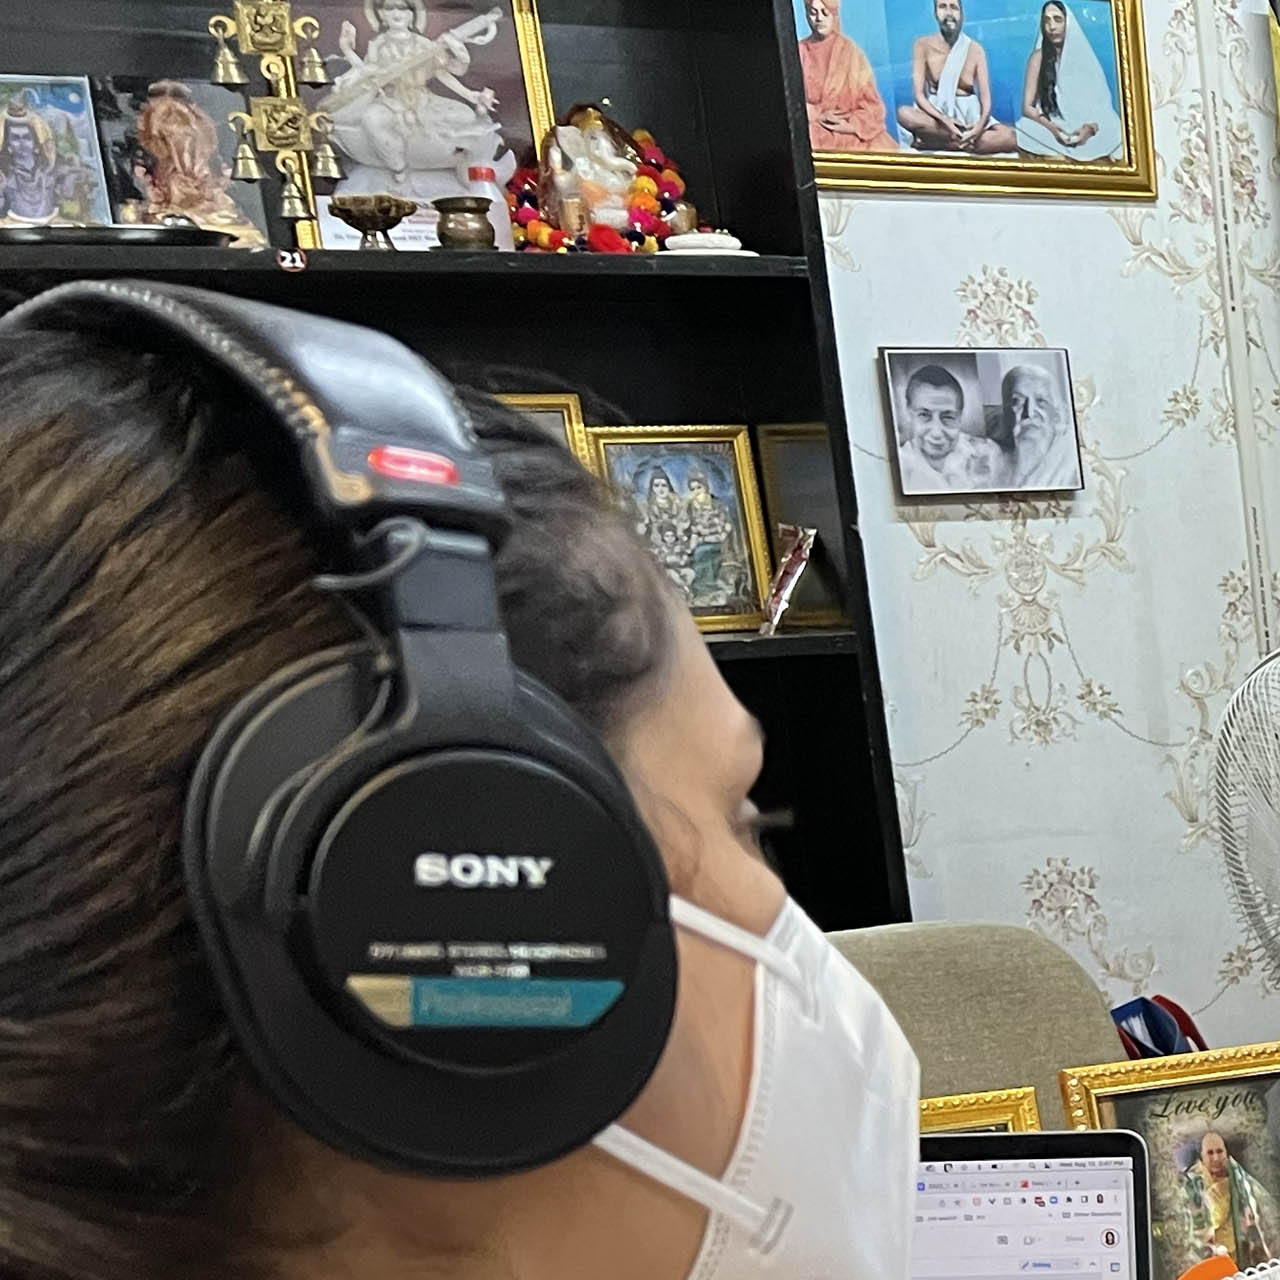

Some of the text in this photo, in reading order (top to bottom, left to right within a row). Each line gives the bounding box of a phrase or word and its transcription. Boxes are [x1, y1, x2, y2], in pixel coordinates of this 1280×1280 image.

[281, 252, 304, 268] 21
[413, 853, 554, 888] SONY
[1149, 1089, 1259, 1120] Love you
